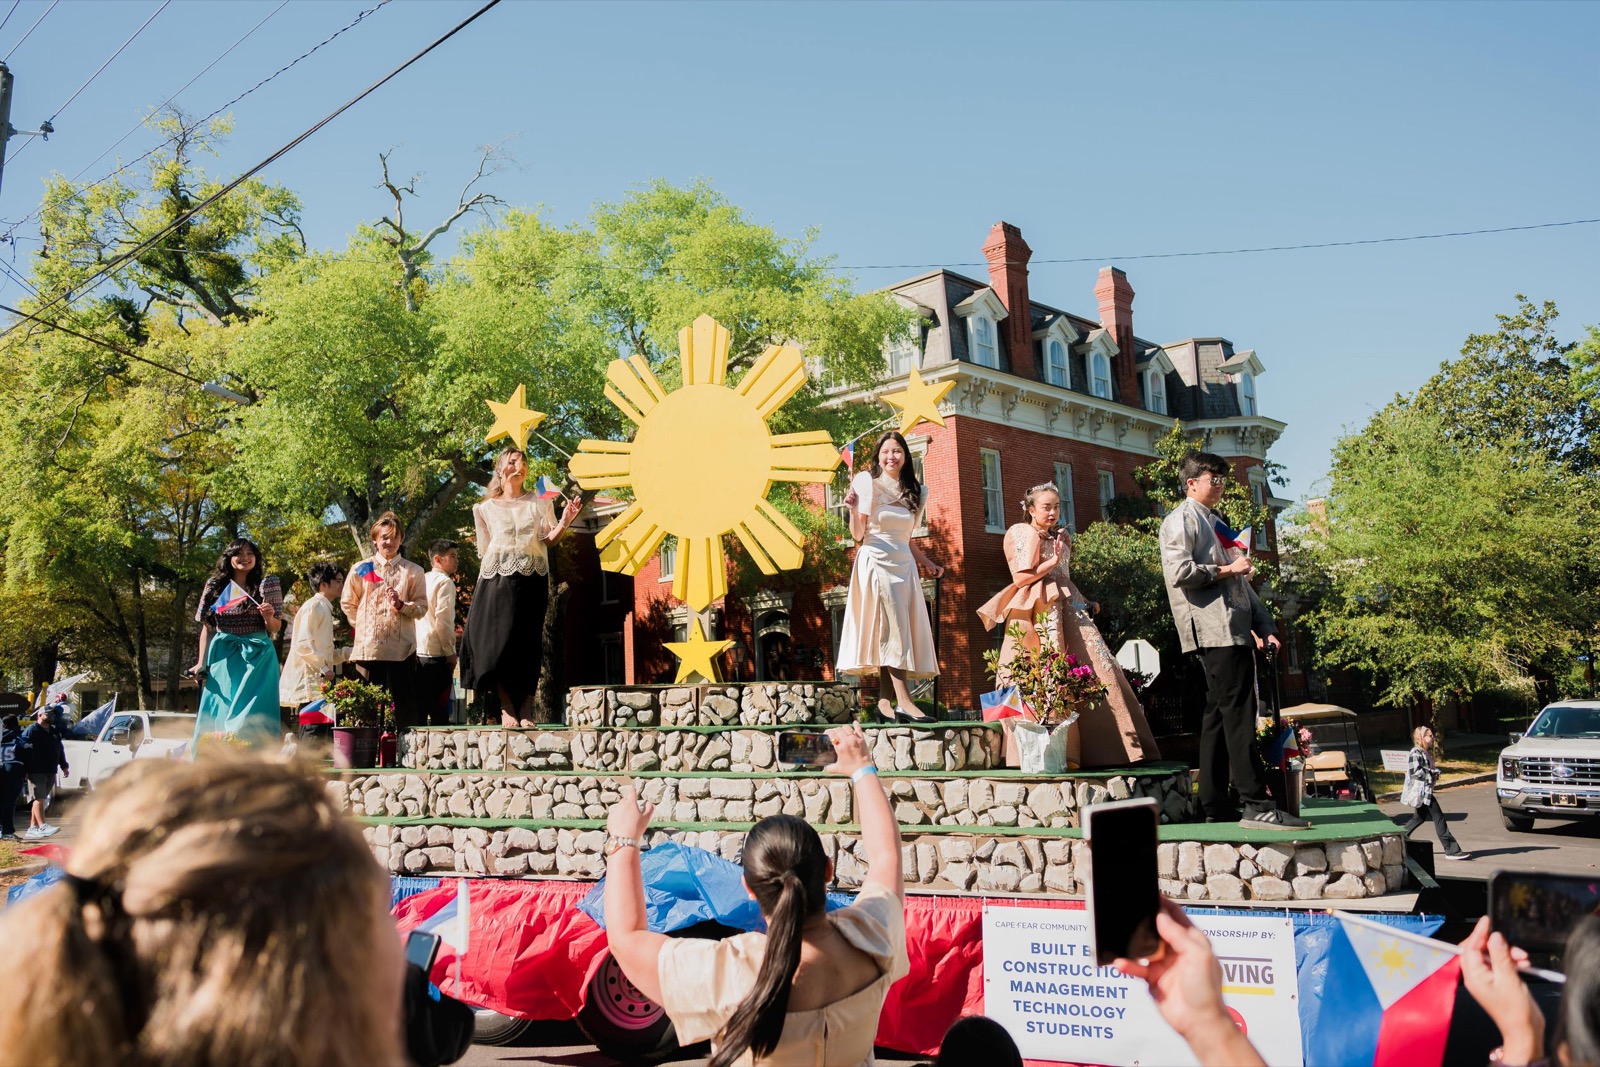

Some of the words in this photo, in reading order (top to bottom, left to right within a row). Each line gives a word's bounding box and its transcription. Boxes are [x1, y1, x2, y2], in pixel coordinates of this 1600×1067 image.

[995, 921, 1015, 929] CAPE
[1017, 922, 1038, 930] FEAR
[1040, 923, 1088, 932] COMMUNITY
[1202, 929, 1258, 939] ONSORSHIP
[1261, 931, 1276, 939] BY:
[1031, 942, 1076, 956] BUILT
[1223, 963, 1274, 985] VING
[1010, 980, 1128, 999] MANAGEMENT
[1013, 1000, 1126, 1019] TECHNOLOGY
[1026, 1021, 1114, 1039] STUDENTS
